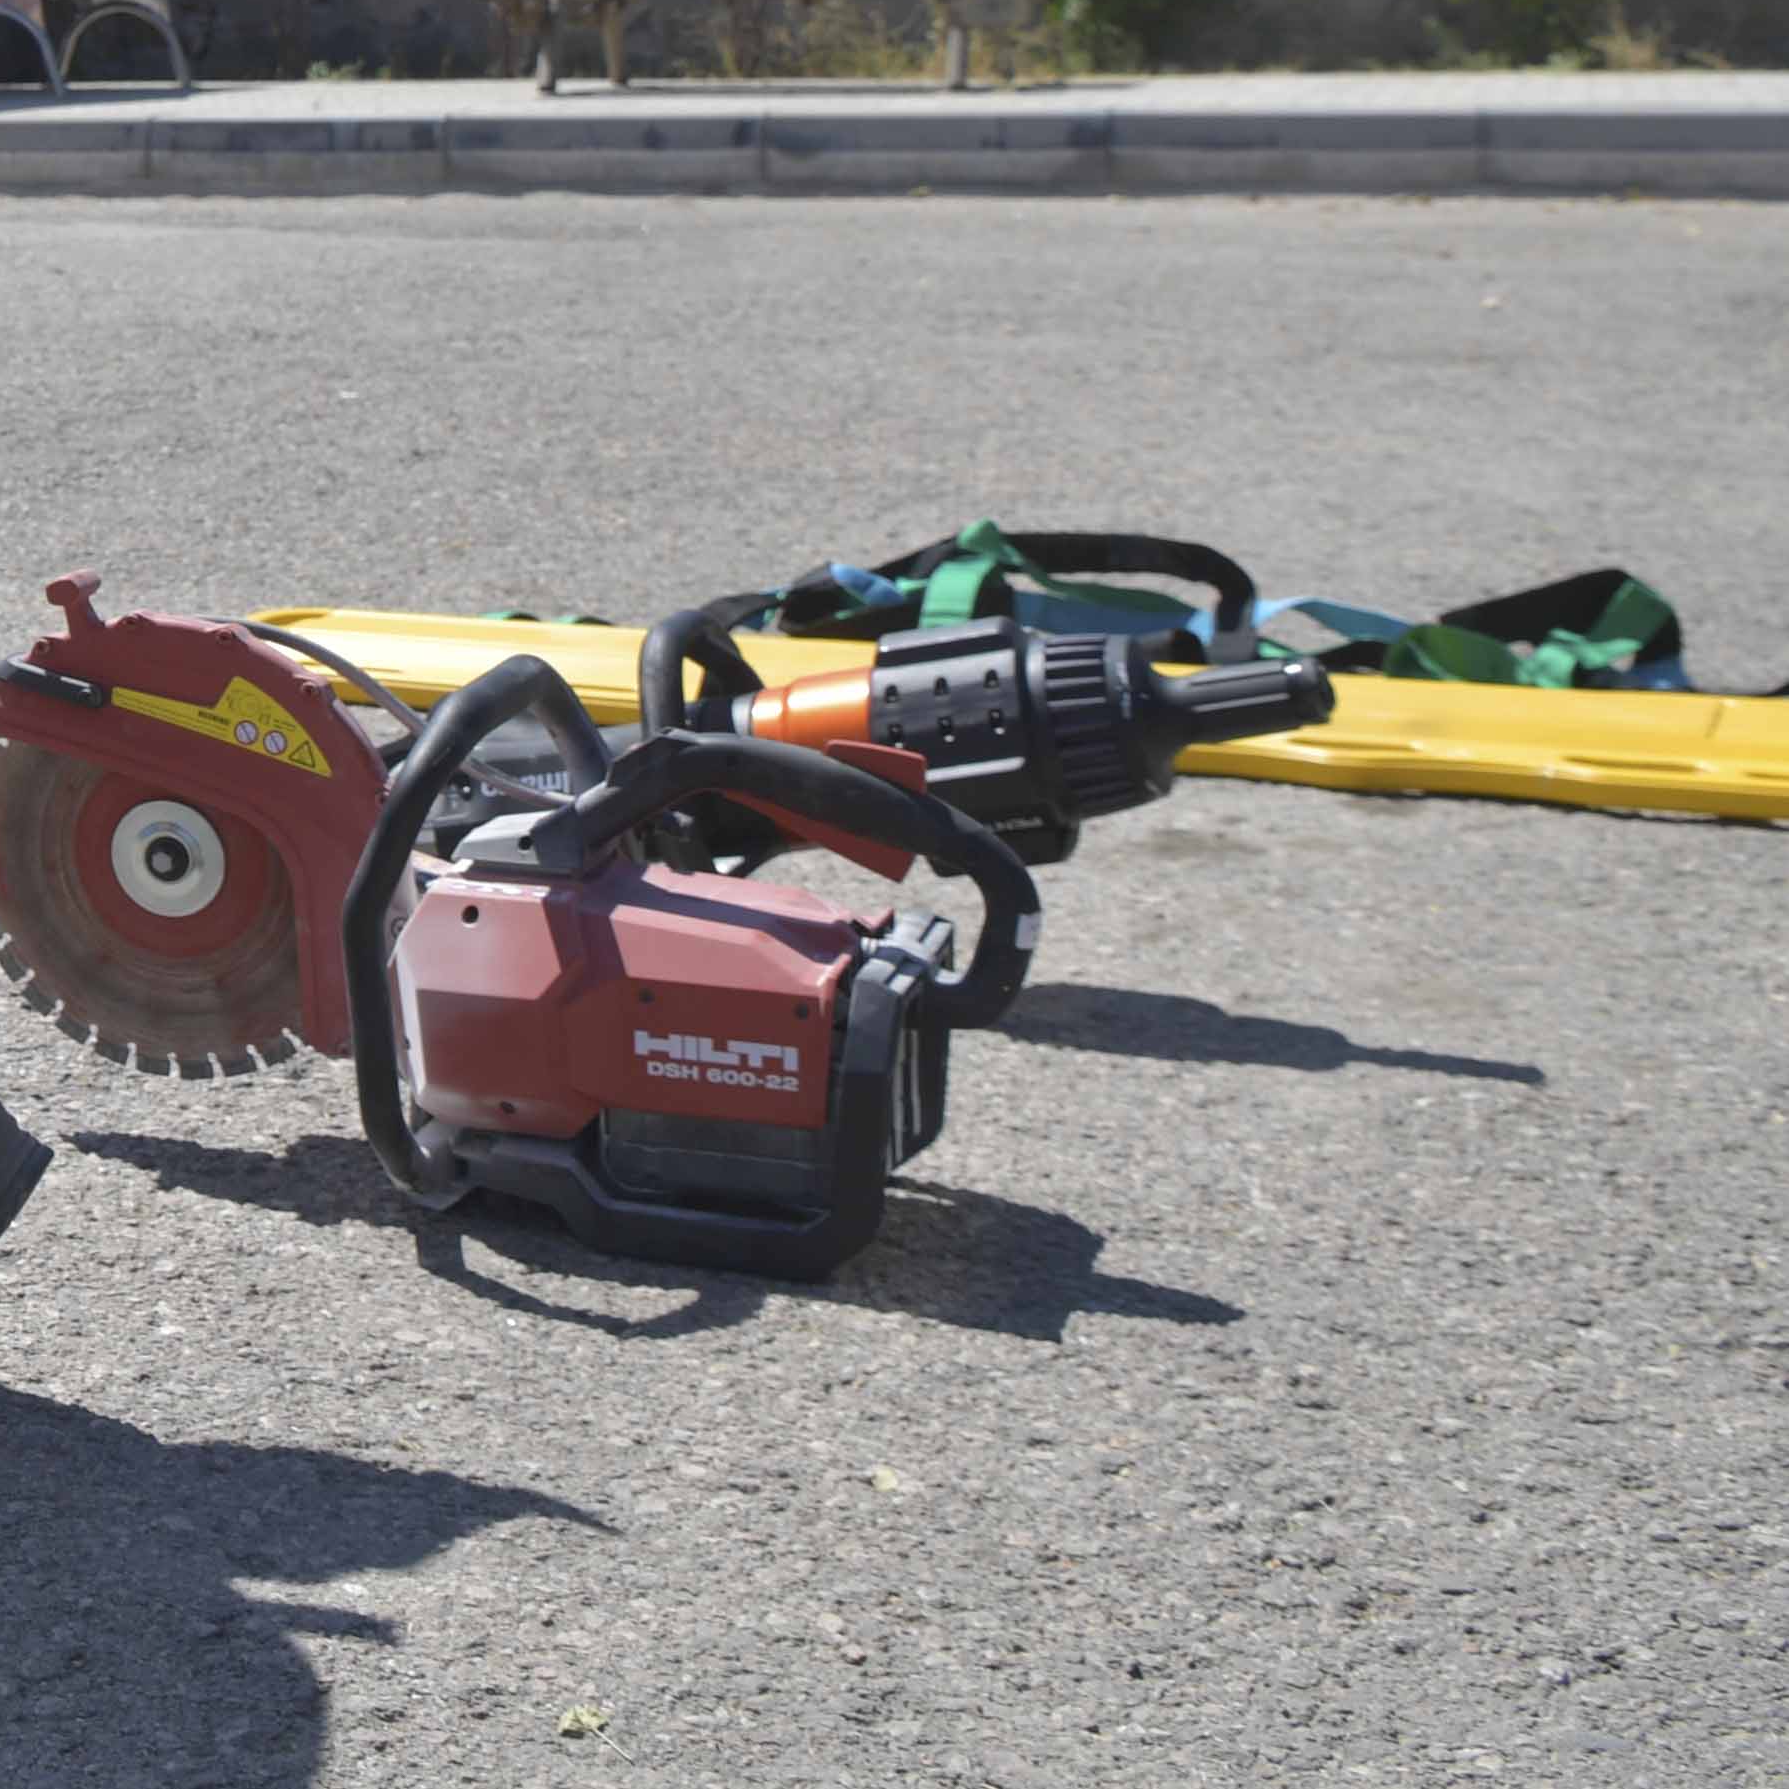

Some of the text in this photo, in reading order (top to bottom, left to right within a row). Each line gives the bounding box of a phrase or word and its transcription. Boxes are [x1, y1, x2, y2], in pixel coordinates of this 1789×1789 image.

[634, 1030, 799, 1071] HILTI
[647, 1061, 799, 1092] DSH 600-22
